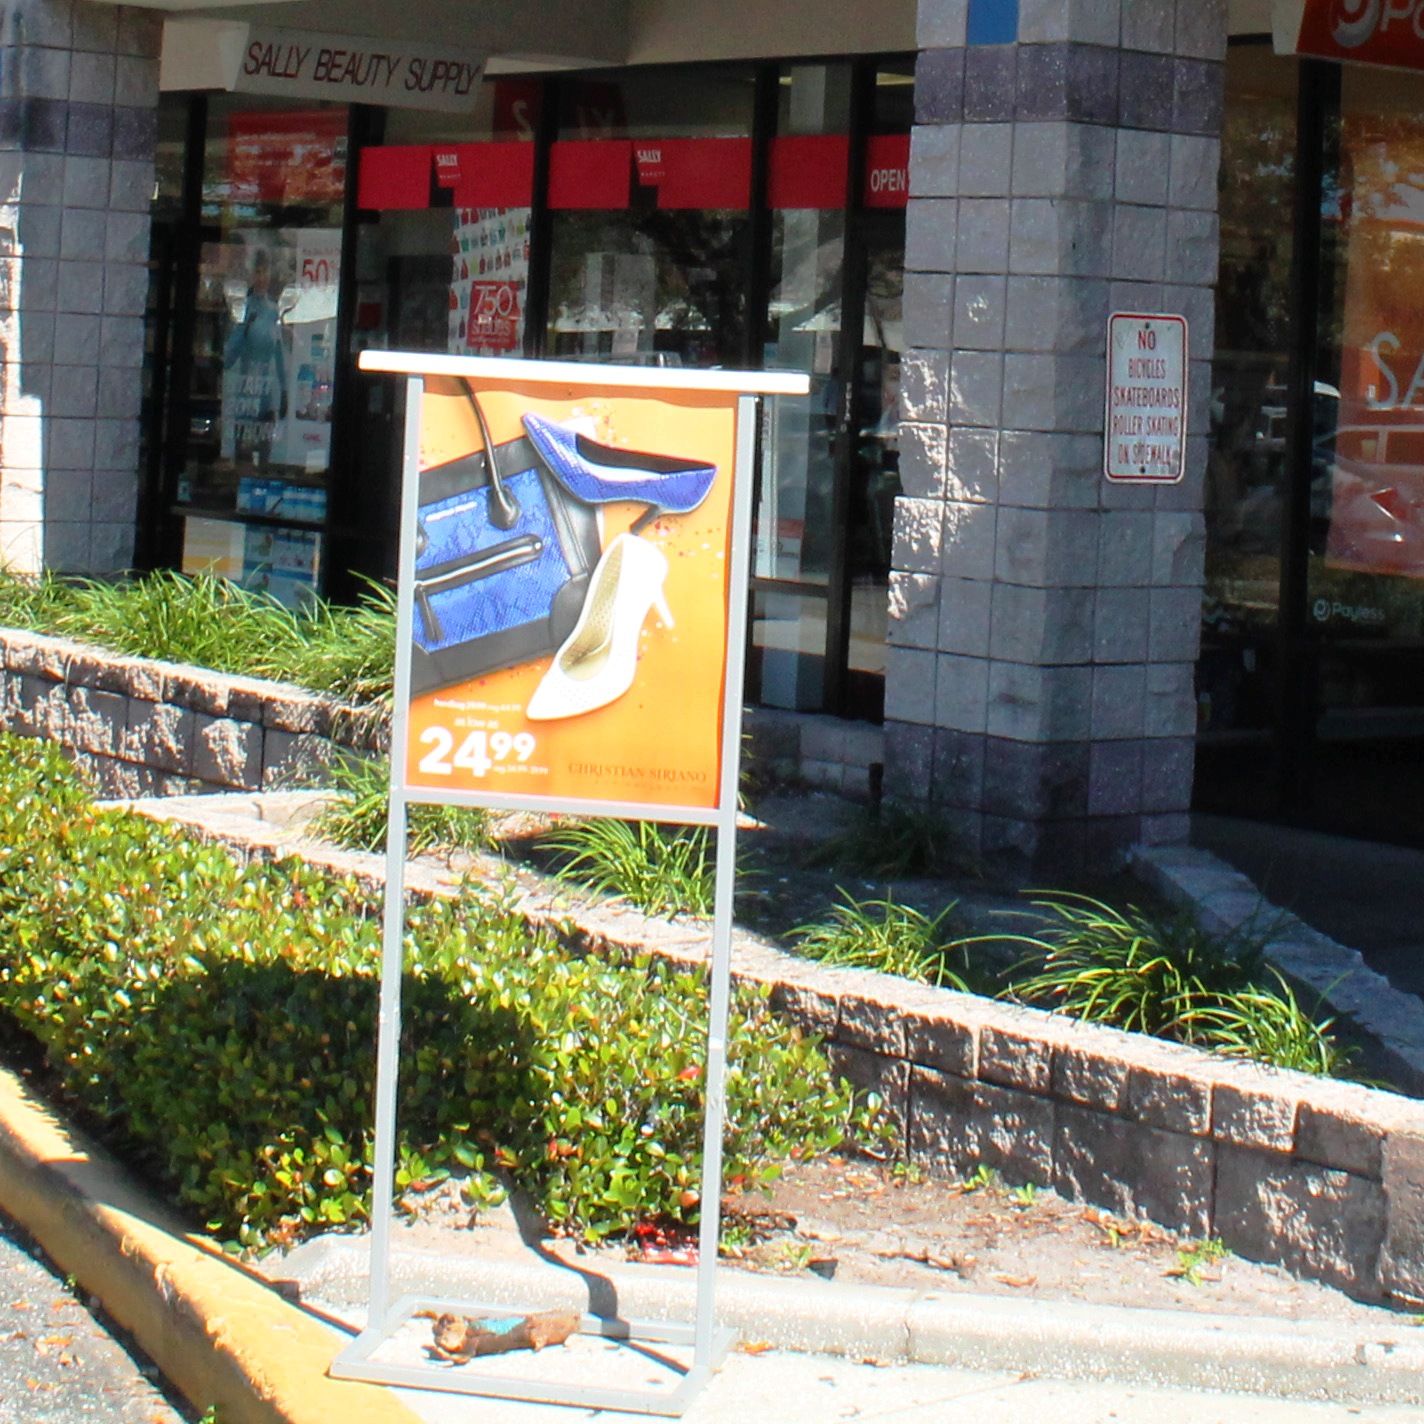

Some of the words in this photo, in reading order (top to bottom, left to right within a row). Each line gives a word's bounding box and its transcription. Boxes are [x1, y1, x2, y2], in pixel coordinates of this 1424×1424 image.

[244, 41, 311, 79] SALLY
[314, 49, 400, 88] BEAUTY
[404, 58, 480, 96] SUPPLY
[436, 154, 458, 166] SALLY
[637, 149, 662, 163] SALLY
[871, 168, 906, 193] OPEN
[474, 285, 513, 316] 750
[1137, 330, 1156, 351] NO
[1128, 358, 1166, 380] BICYCLES
[1113, 386, 1181, 408] SKATEBOARDS
[1112, 415, 1143, 436] ROLLER
[1146, 416, 1180, 438] SKATING
[1117, 444, 1130, 465] ON
[1133, 444, 1172, 466] SIDEWALK
[1332, 602, 1385, 622] Payless
[454, 717, 466, 727] as
[466, 715, 486, 728] low
[487, 719, 499, 729] as
[568, 762, 646, 778] CHRISTIAN
[649, 767, 707, 783] SIRIANO
